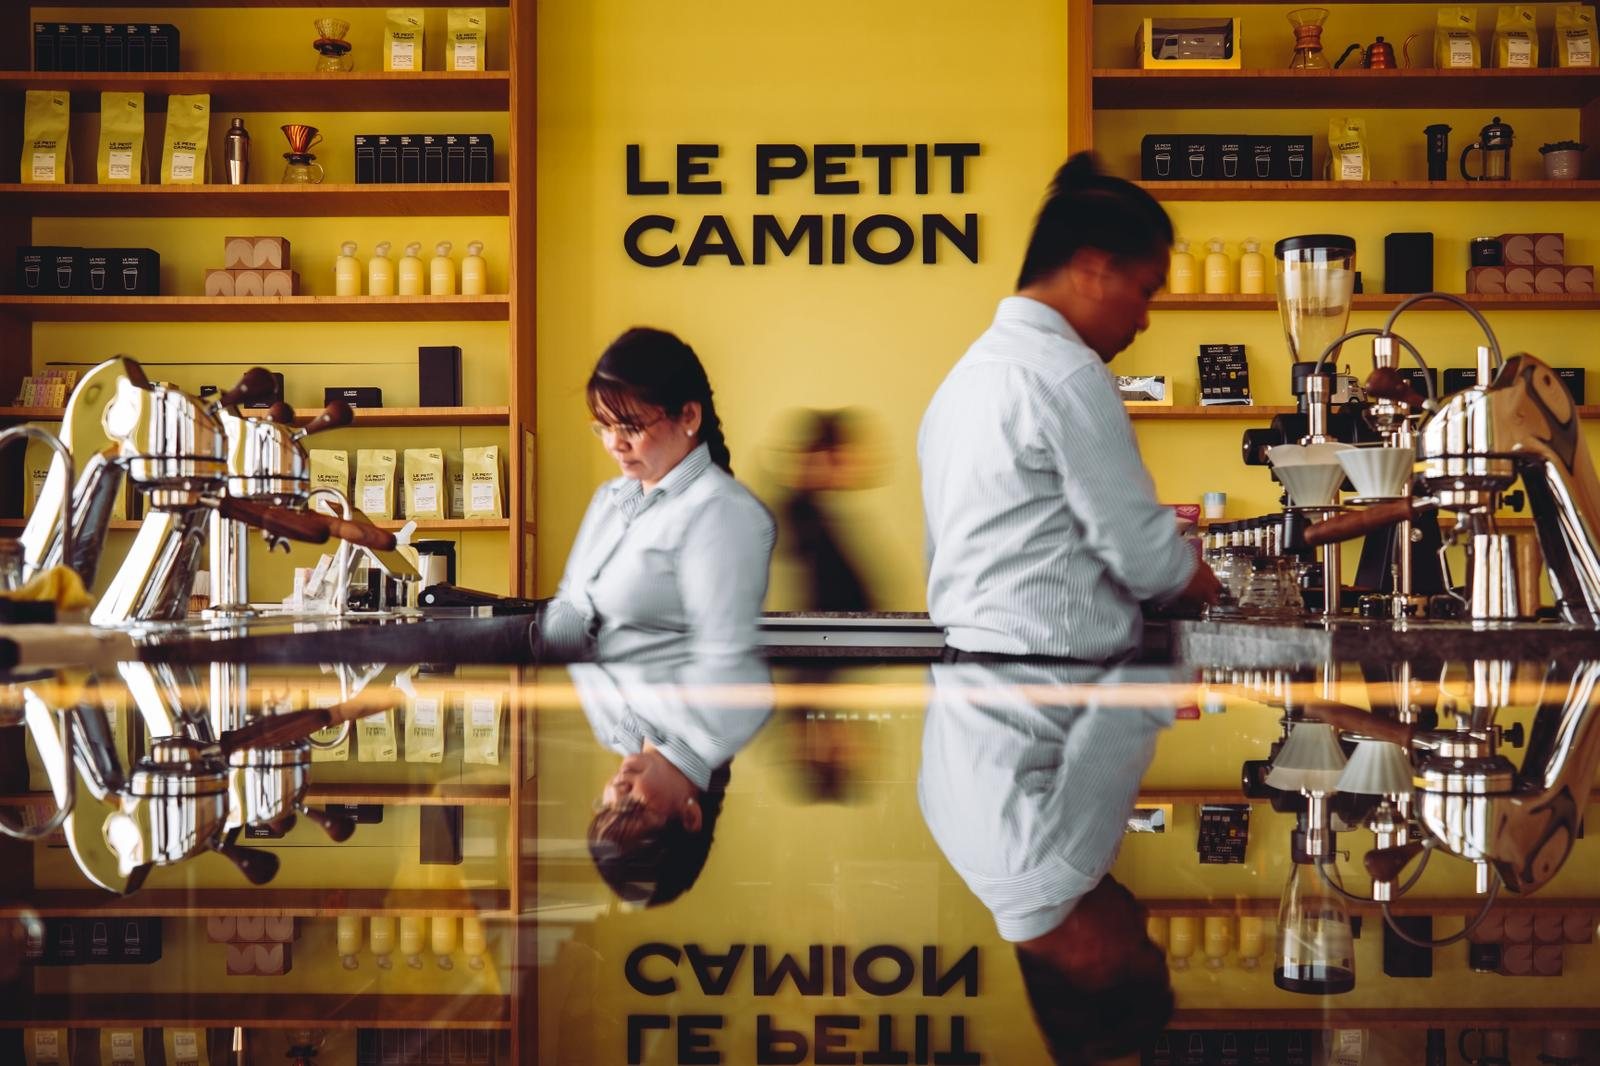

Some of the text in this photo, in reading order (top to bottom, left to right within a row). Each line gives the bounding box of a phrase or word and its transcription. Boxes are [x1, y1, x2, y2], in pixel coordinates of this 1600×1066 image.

[626, 143, 981, 195] LE PETIT
[624, 213, 979, 267] CAMION
